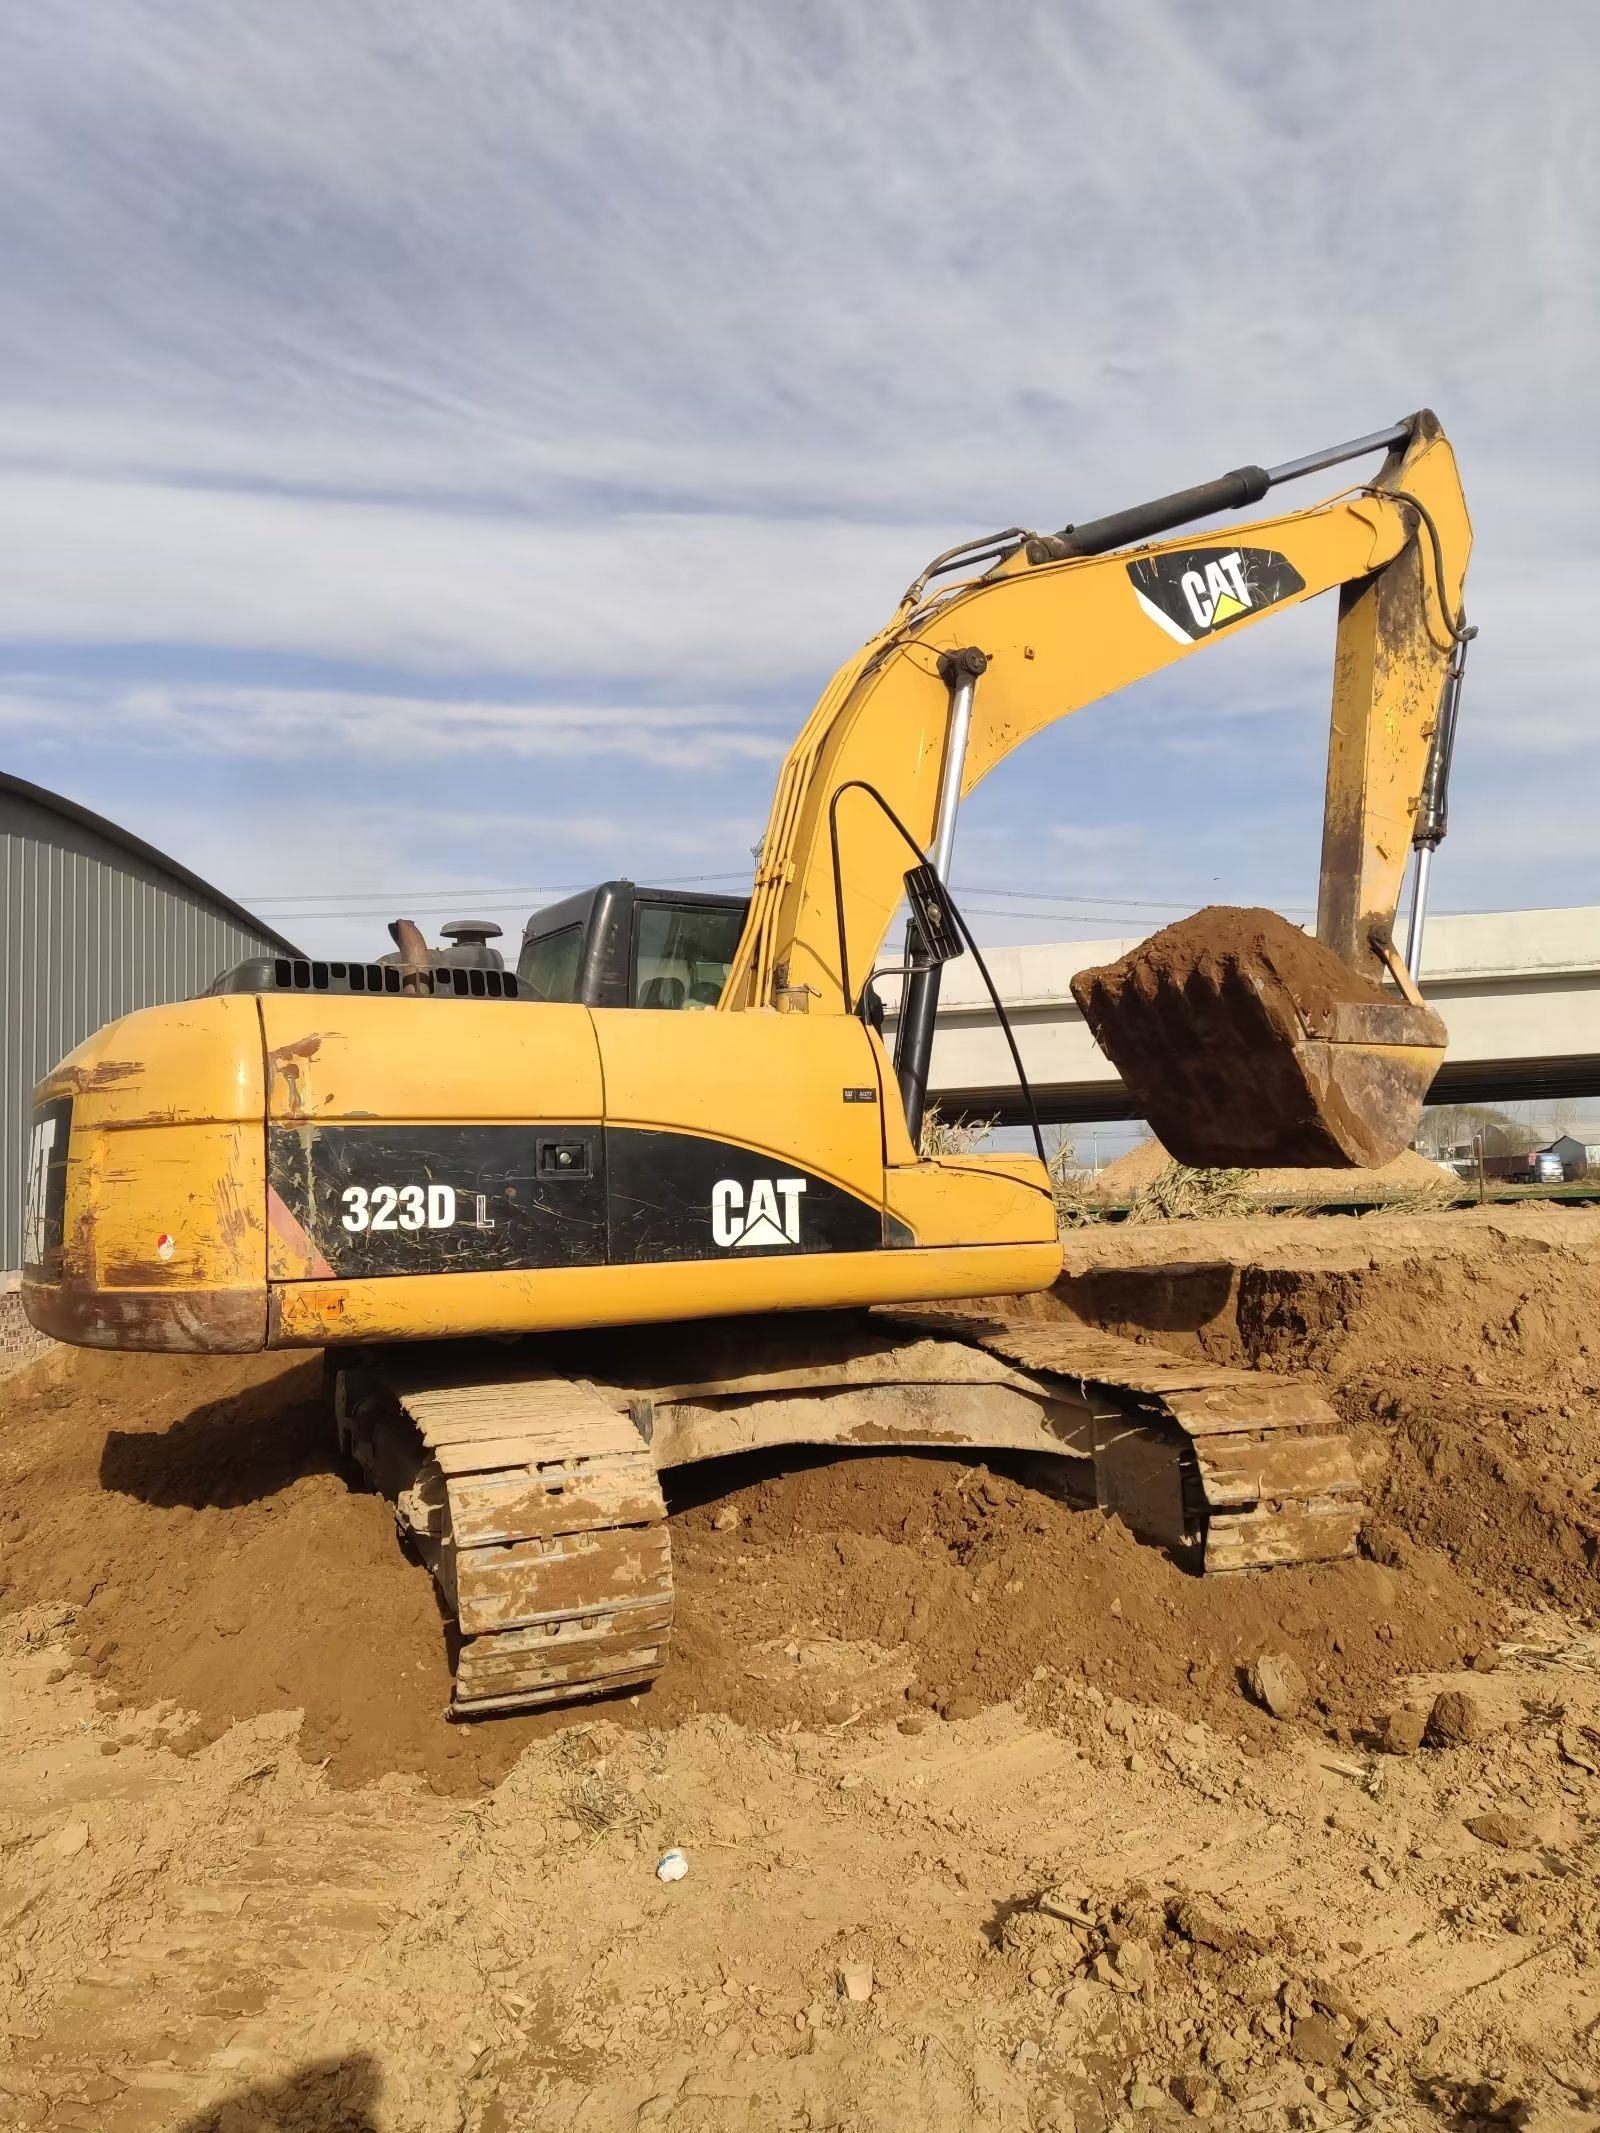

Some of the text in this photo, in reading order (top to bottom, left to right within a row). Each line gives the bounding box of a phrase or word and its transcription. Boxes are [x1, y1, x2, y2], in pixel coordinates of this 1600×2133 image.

[1181, 552, 1253, 628] CAT
[341, 1184, 495, 1232] 323D L
[711, 1179, 807, 1247] CAT
